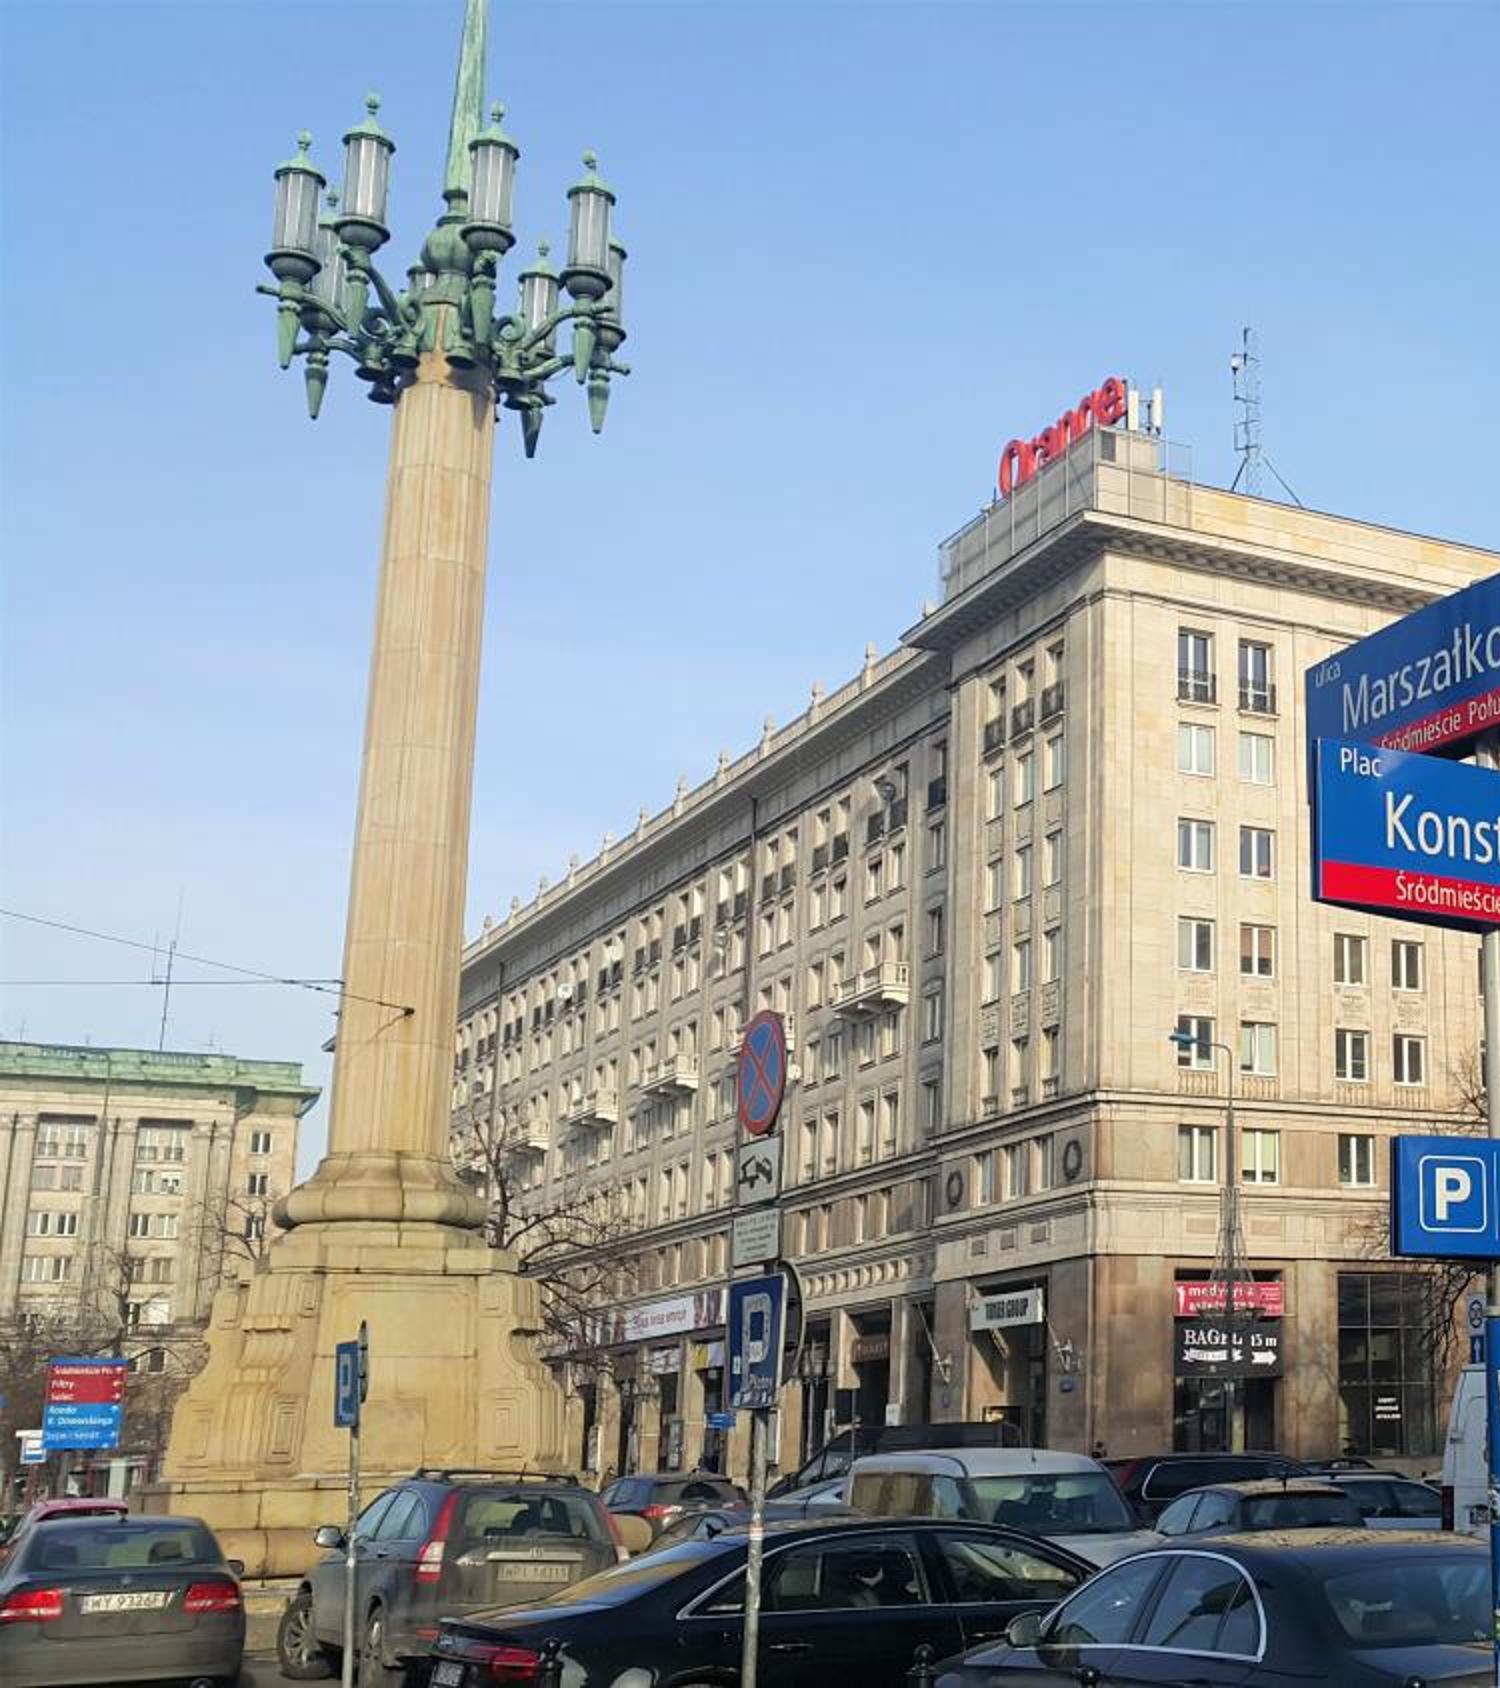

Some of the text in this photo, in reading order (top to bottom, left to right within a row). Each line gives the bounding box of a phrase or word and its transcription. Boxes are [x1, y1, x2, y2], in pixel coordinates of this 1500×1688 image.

[1315, 662, 1341, 688] ulica
[1340, 747, 1383, 777] Plac
[1435, 1167, 1472, 1221] P
